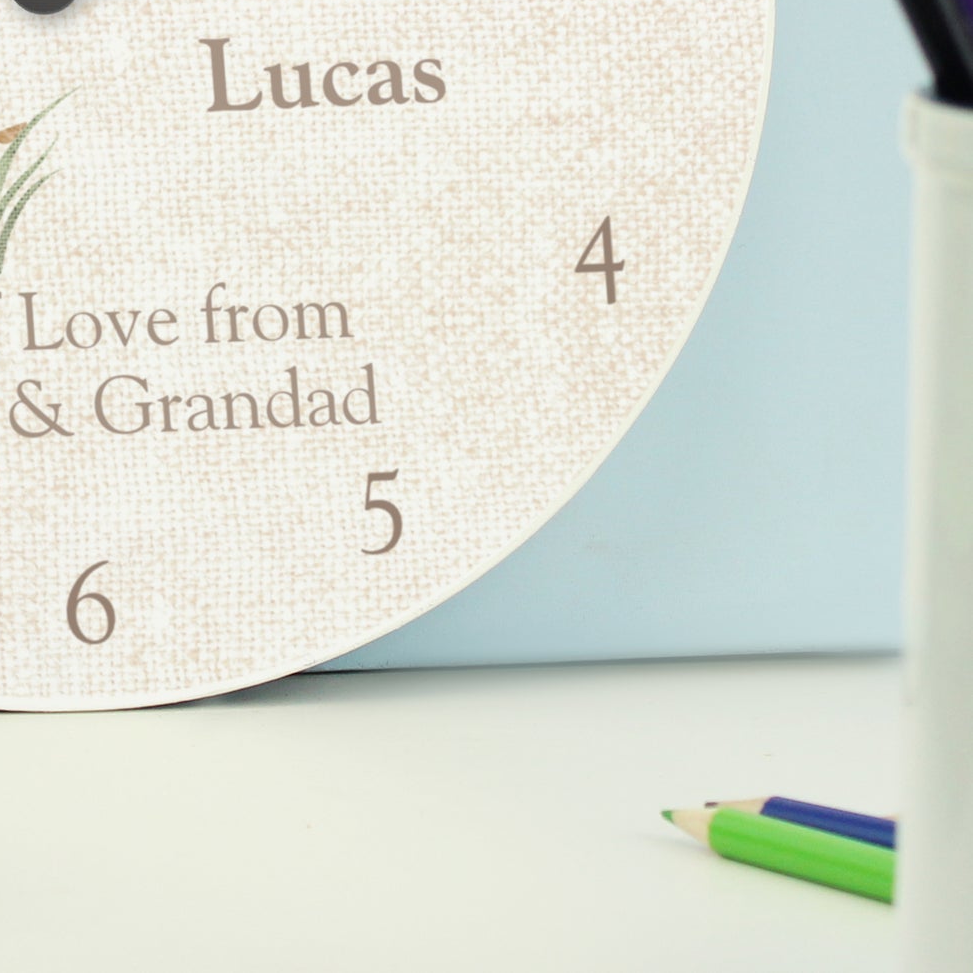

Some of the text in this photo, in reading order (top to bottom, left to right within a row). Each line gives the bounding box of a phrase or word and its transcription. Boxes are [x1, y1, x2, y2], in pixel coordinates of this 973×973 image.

[198, 35, 447, 113] Lucas
[573, 215, 626, 306] 4
[23, 291, 178, 351] Love
[200, 281, 355, 344] from
[8, 380, 74, 439] &
[93, 362, 381, 435] Grandad
[361, 468, 404, 556] 5
[65, 559, 117, 646] 6
